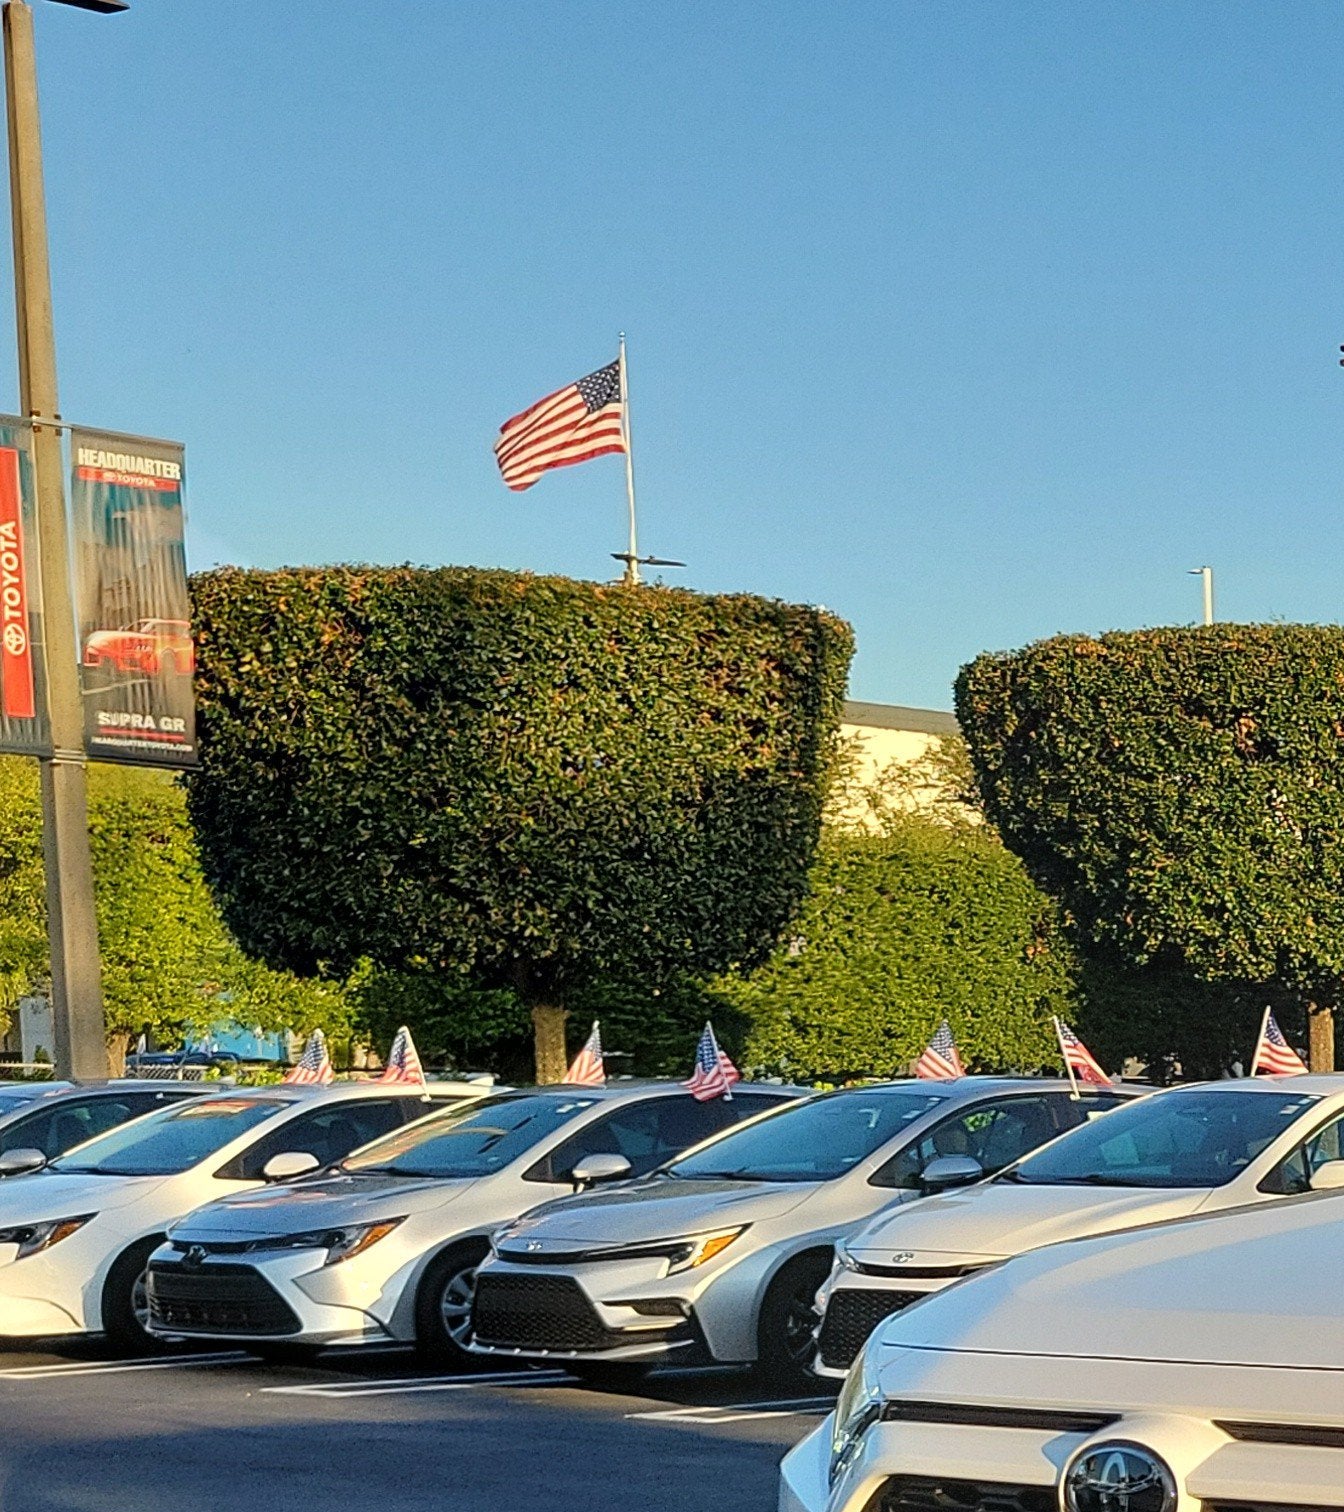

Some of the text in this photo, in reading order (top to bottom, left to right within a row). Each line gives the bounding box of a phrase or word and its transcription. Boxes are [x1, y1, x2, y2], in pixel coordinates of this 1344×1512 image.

[78, 448, 181, 480] HEADQUARTER
[117, 474, 156, 487] TOYOTA
[0, 521, 22, 621] TOYOTA
[98, 711, 186, 732] SUPRA GR
